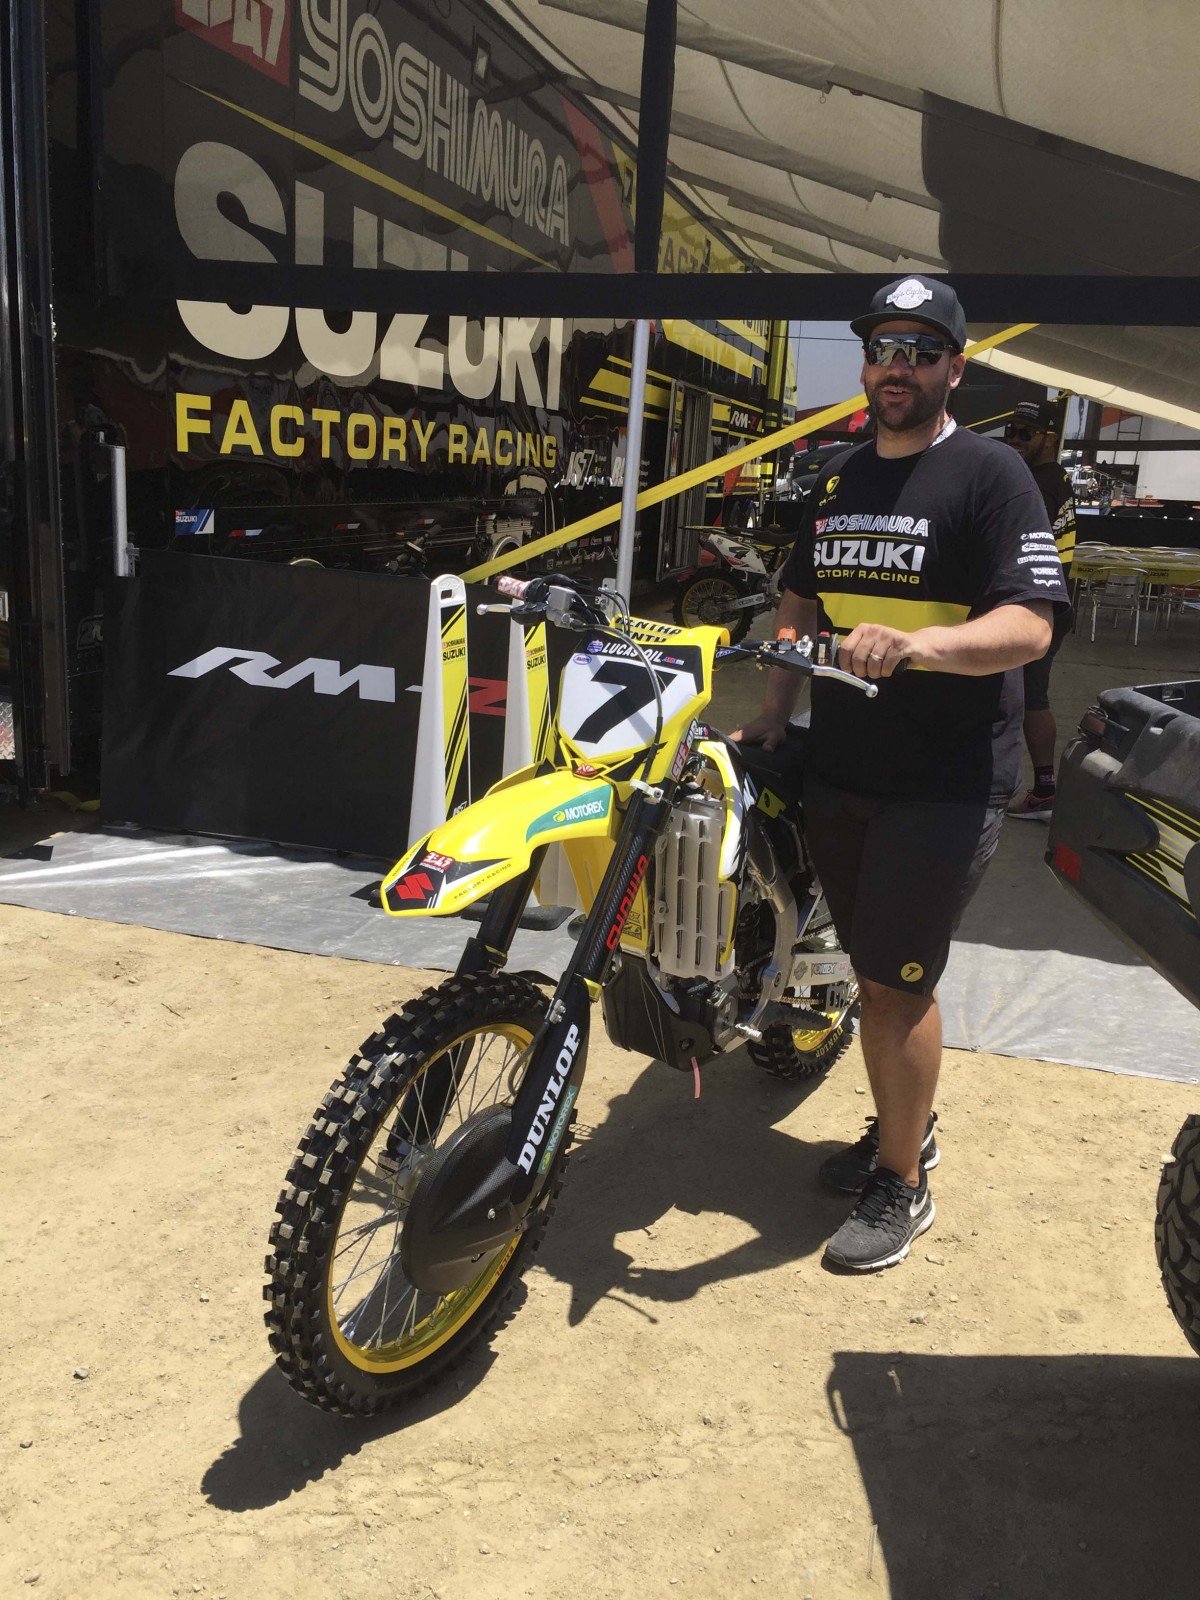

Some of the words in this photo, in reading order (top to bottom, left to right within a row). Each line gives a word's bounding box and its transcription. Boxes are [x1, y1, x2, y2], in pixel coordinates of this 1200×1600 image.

[298, 0, 570, 247] YOSHIMURA
[174, 141, 564, 411] SUZUKI
[176, 392, 434, 463] FACTORY
[448, 423, 557, 468] RACING
[175, 515, 198, 523] SUZUKI
[826, 514, 929, 537] YOSHIMURA
[813, 540, 926, 572] SUZUKI
[816, 568, 856, 579] CTORY
[858, 569, 920, 585] RACING
[442, 646, 466, 662] SUZUKI
[526, 653, 547, 671] SUZUKI
[602, 642, 640, 658] LUCAS
[643, 648, 663, 663] OIL
[572, 659, 678, 744] 7
[564, 800, 605, 822] MOTOREX
[487, 863, 512, 879] RACING
[815, 1024, 844, 1058] DUNLOP
[516, 1023, 580, 1174] DUNLOP
[547, 1092, 576, 1150] MOTOREX
